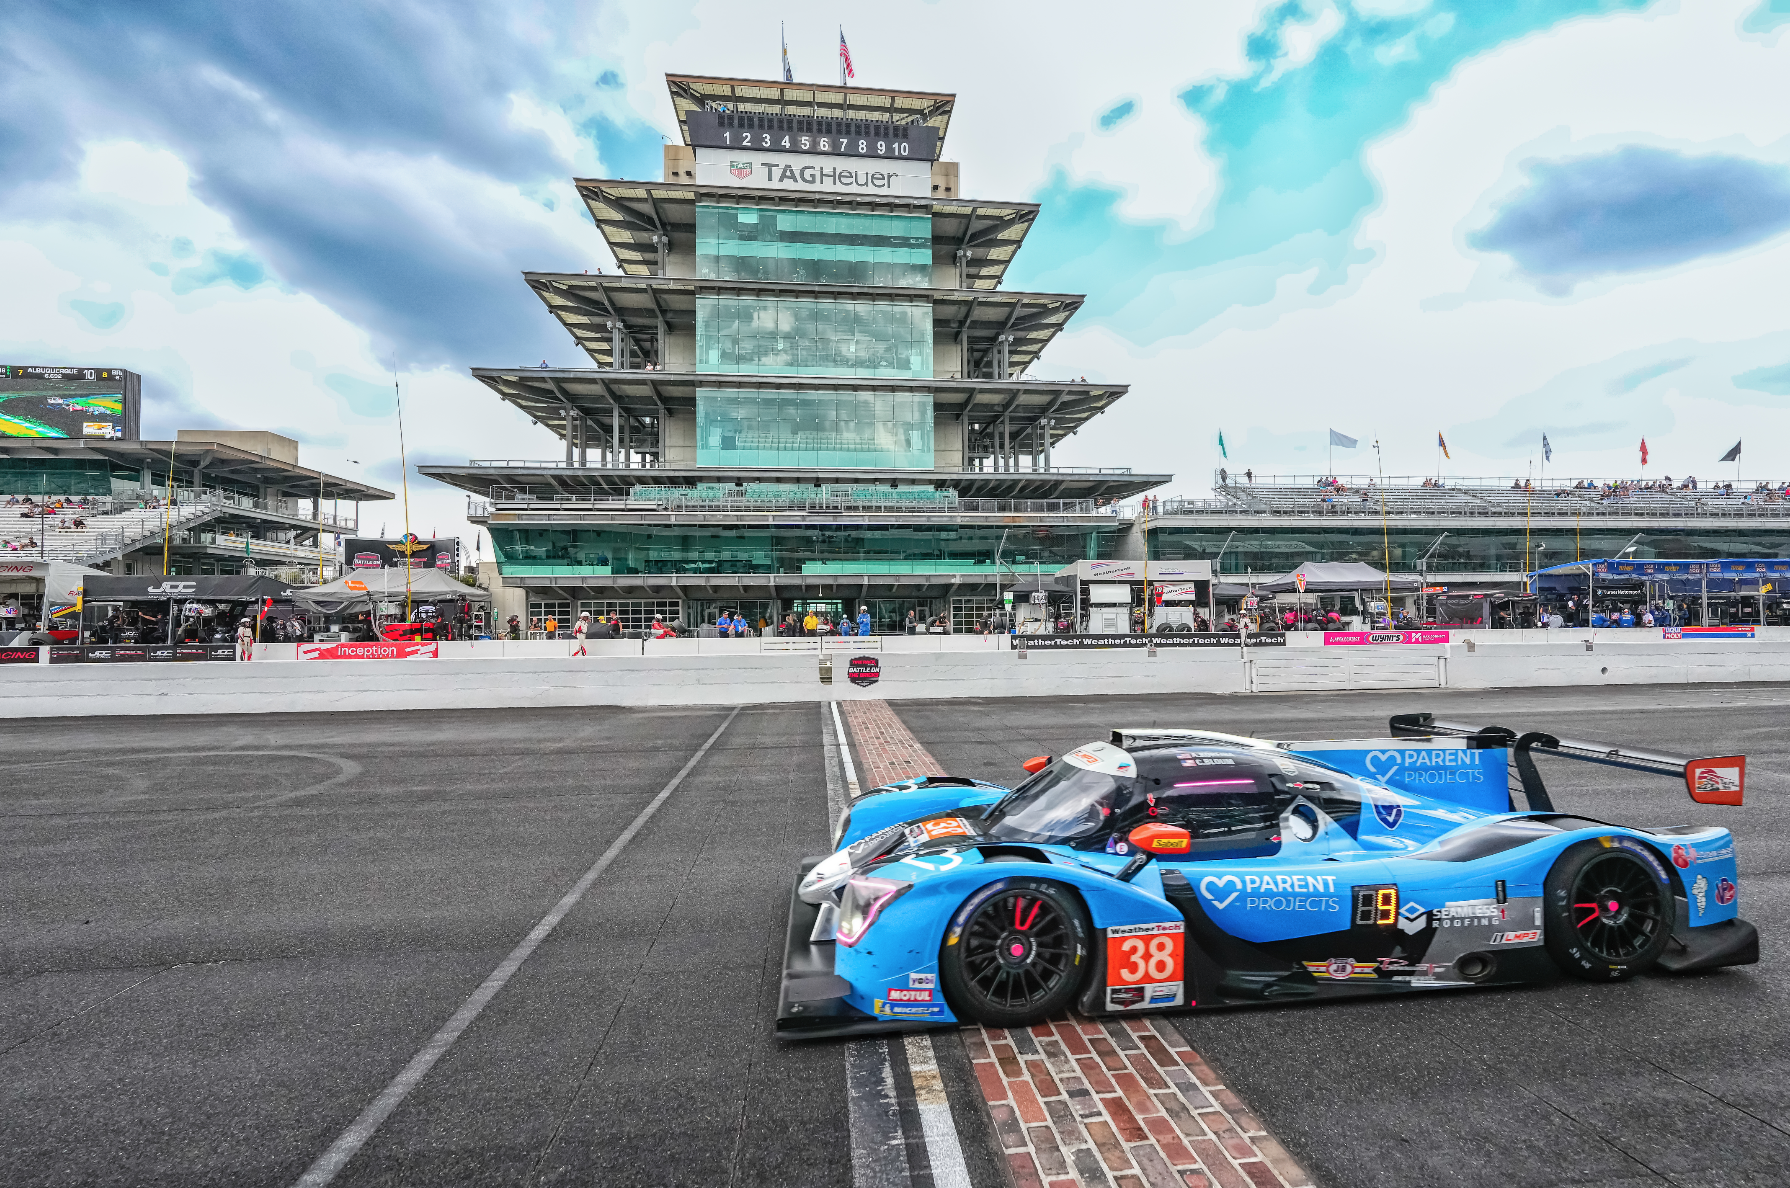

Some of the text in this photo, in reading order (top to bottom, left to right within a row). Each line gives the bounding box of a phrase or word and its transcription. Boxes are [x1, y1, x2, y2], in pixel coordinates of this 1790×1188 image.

[723, 131, 909, 156] 1 2 3 4 5 6 7 8 9 10
[732, 162, 750, 170] TAG
[83, 370, 95, 380] 10
[1082, 637, 1150, 645] WeatherTech
[337, 645, 397, 658] inception
[1404, 749, 1484, 767] PARENT
[1404, 769, 1485, 784] PROJECTS
[1244, 875, 1337, 893] PARENT
[1246, 896, 1340, 912] PROJECTS
[1432, 904, 1498, 919] SEAMLESS
[1432, 917, 1499, 928] ROOFING
[1110, 924, 1182, 935] WeatherTech
[1504, 931, 1538, 942] LMP3
[1120, 935, 1175, 983] 38
[889, 990, 932, 1001] MOTUL
